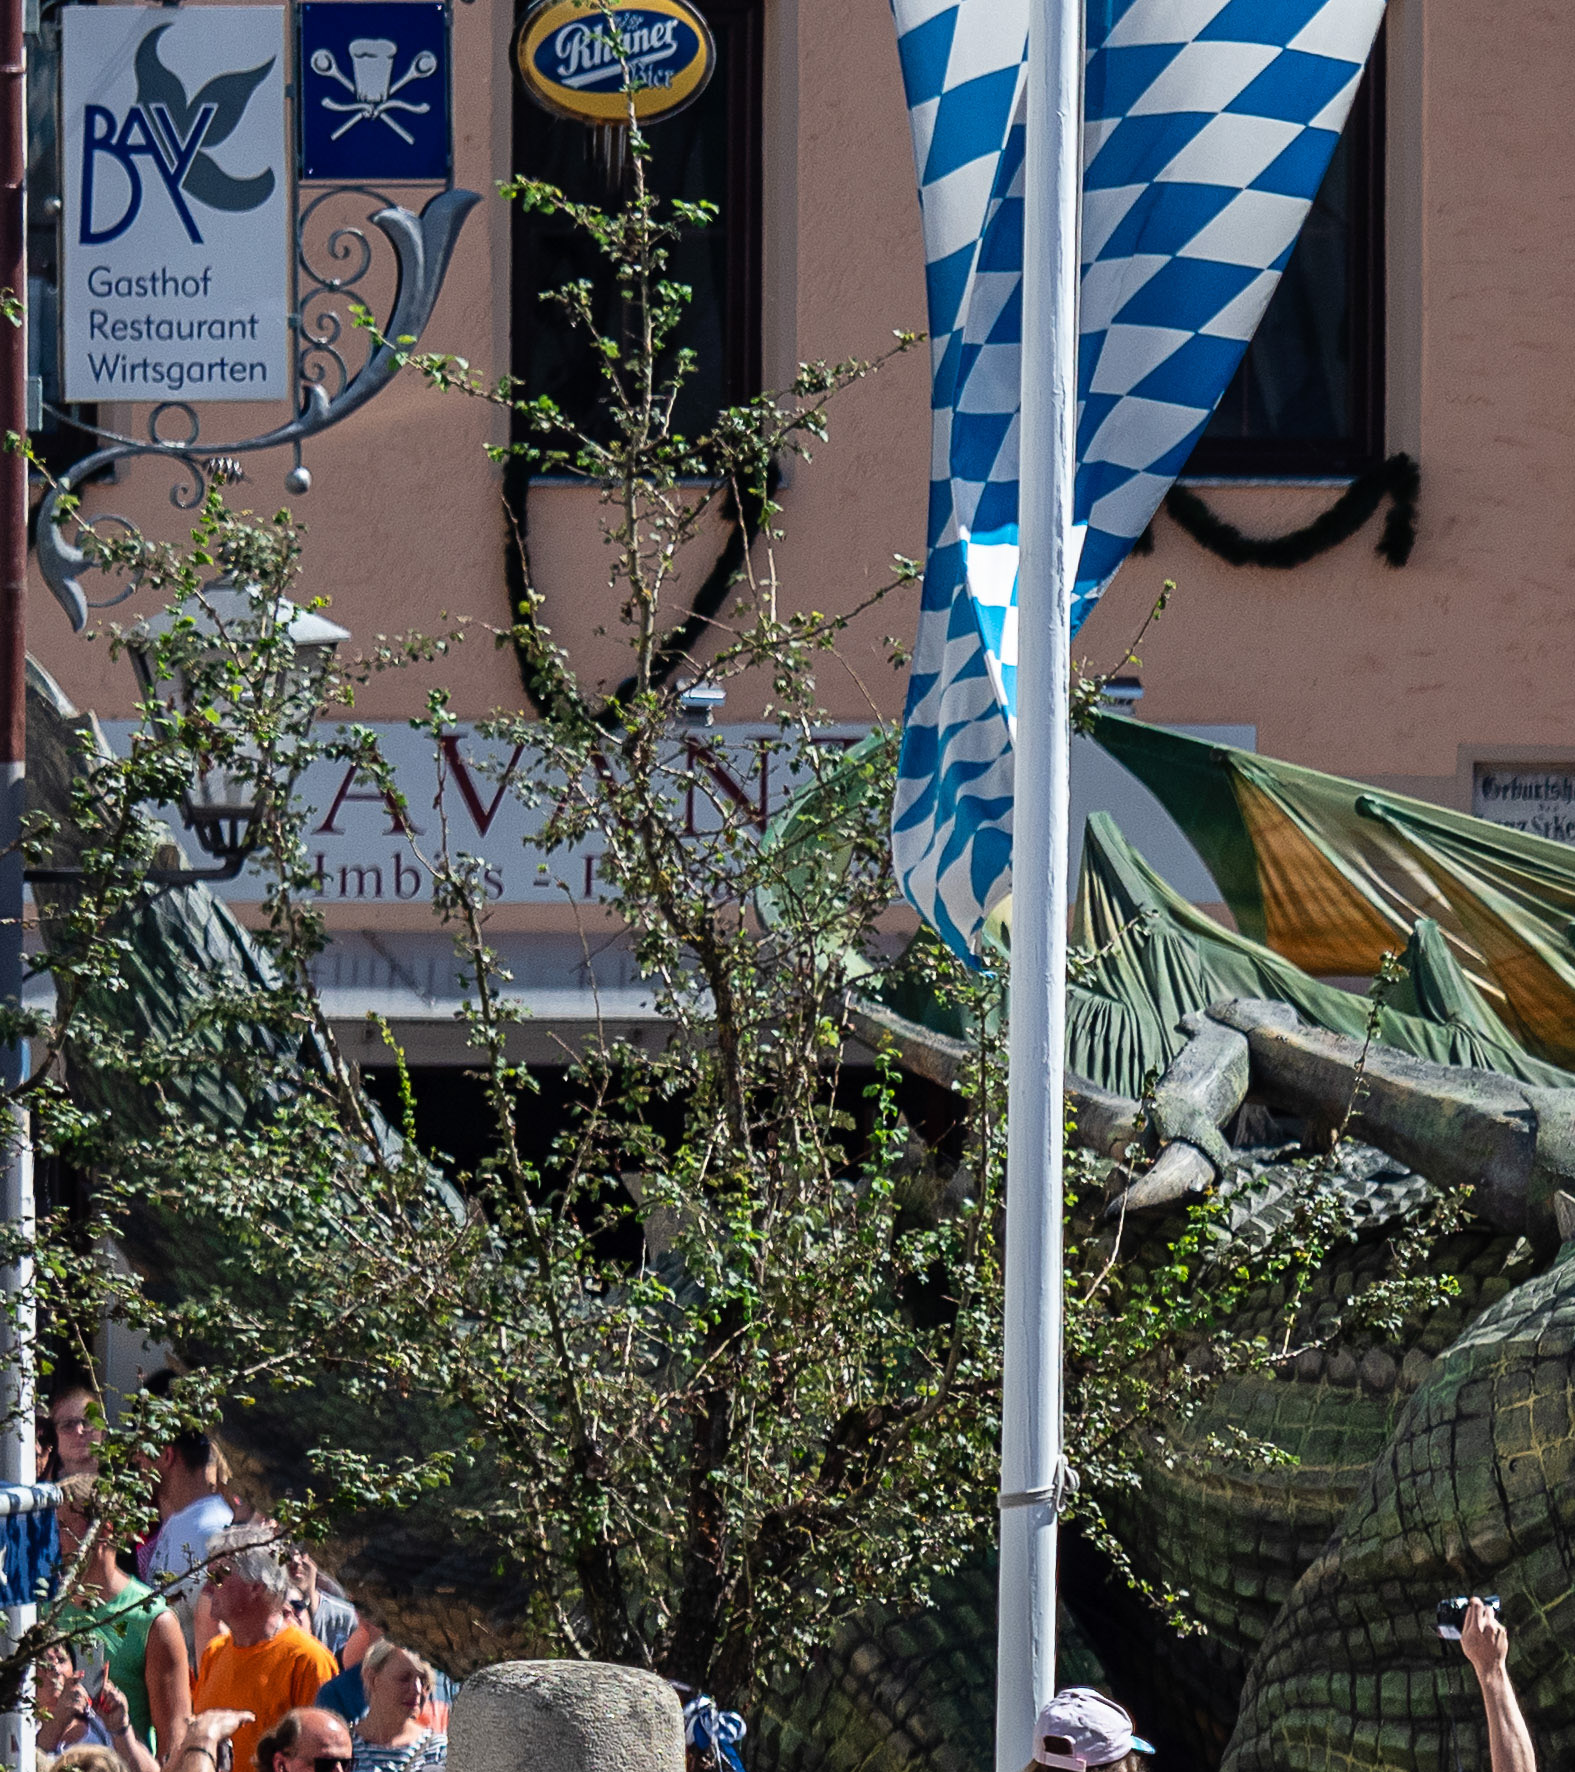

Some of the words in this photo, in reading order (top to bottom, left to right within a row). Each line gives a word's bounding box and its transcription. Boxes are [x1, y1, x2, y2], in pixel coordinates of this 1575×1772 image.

[87, 265, 212, 299] Gasthof
[89, 309, 259, 341] Restaurant
[87, 353, 267, 390] Wirtsgarten
